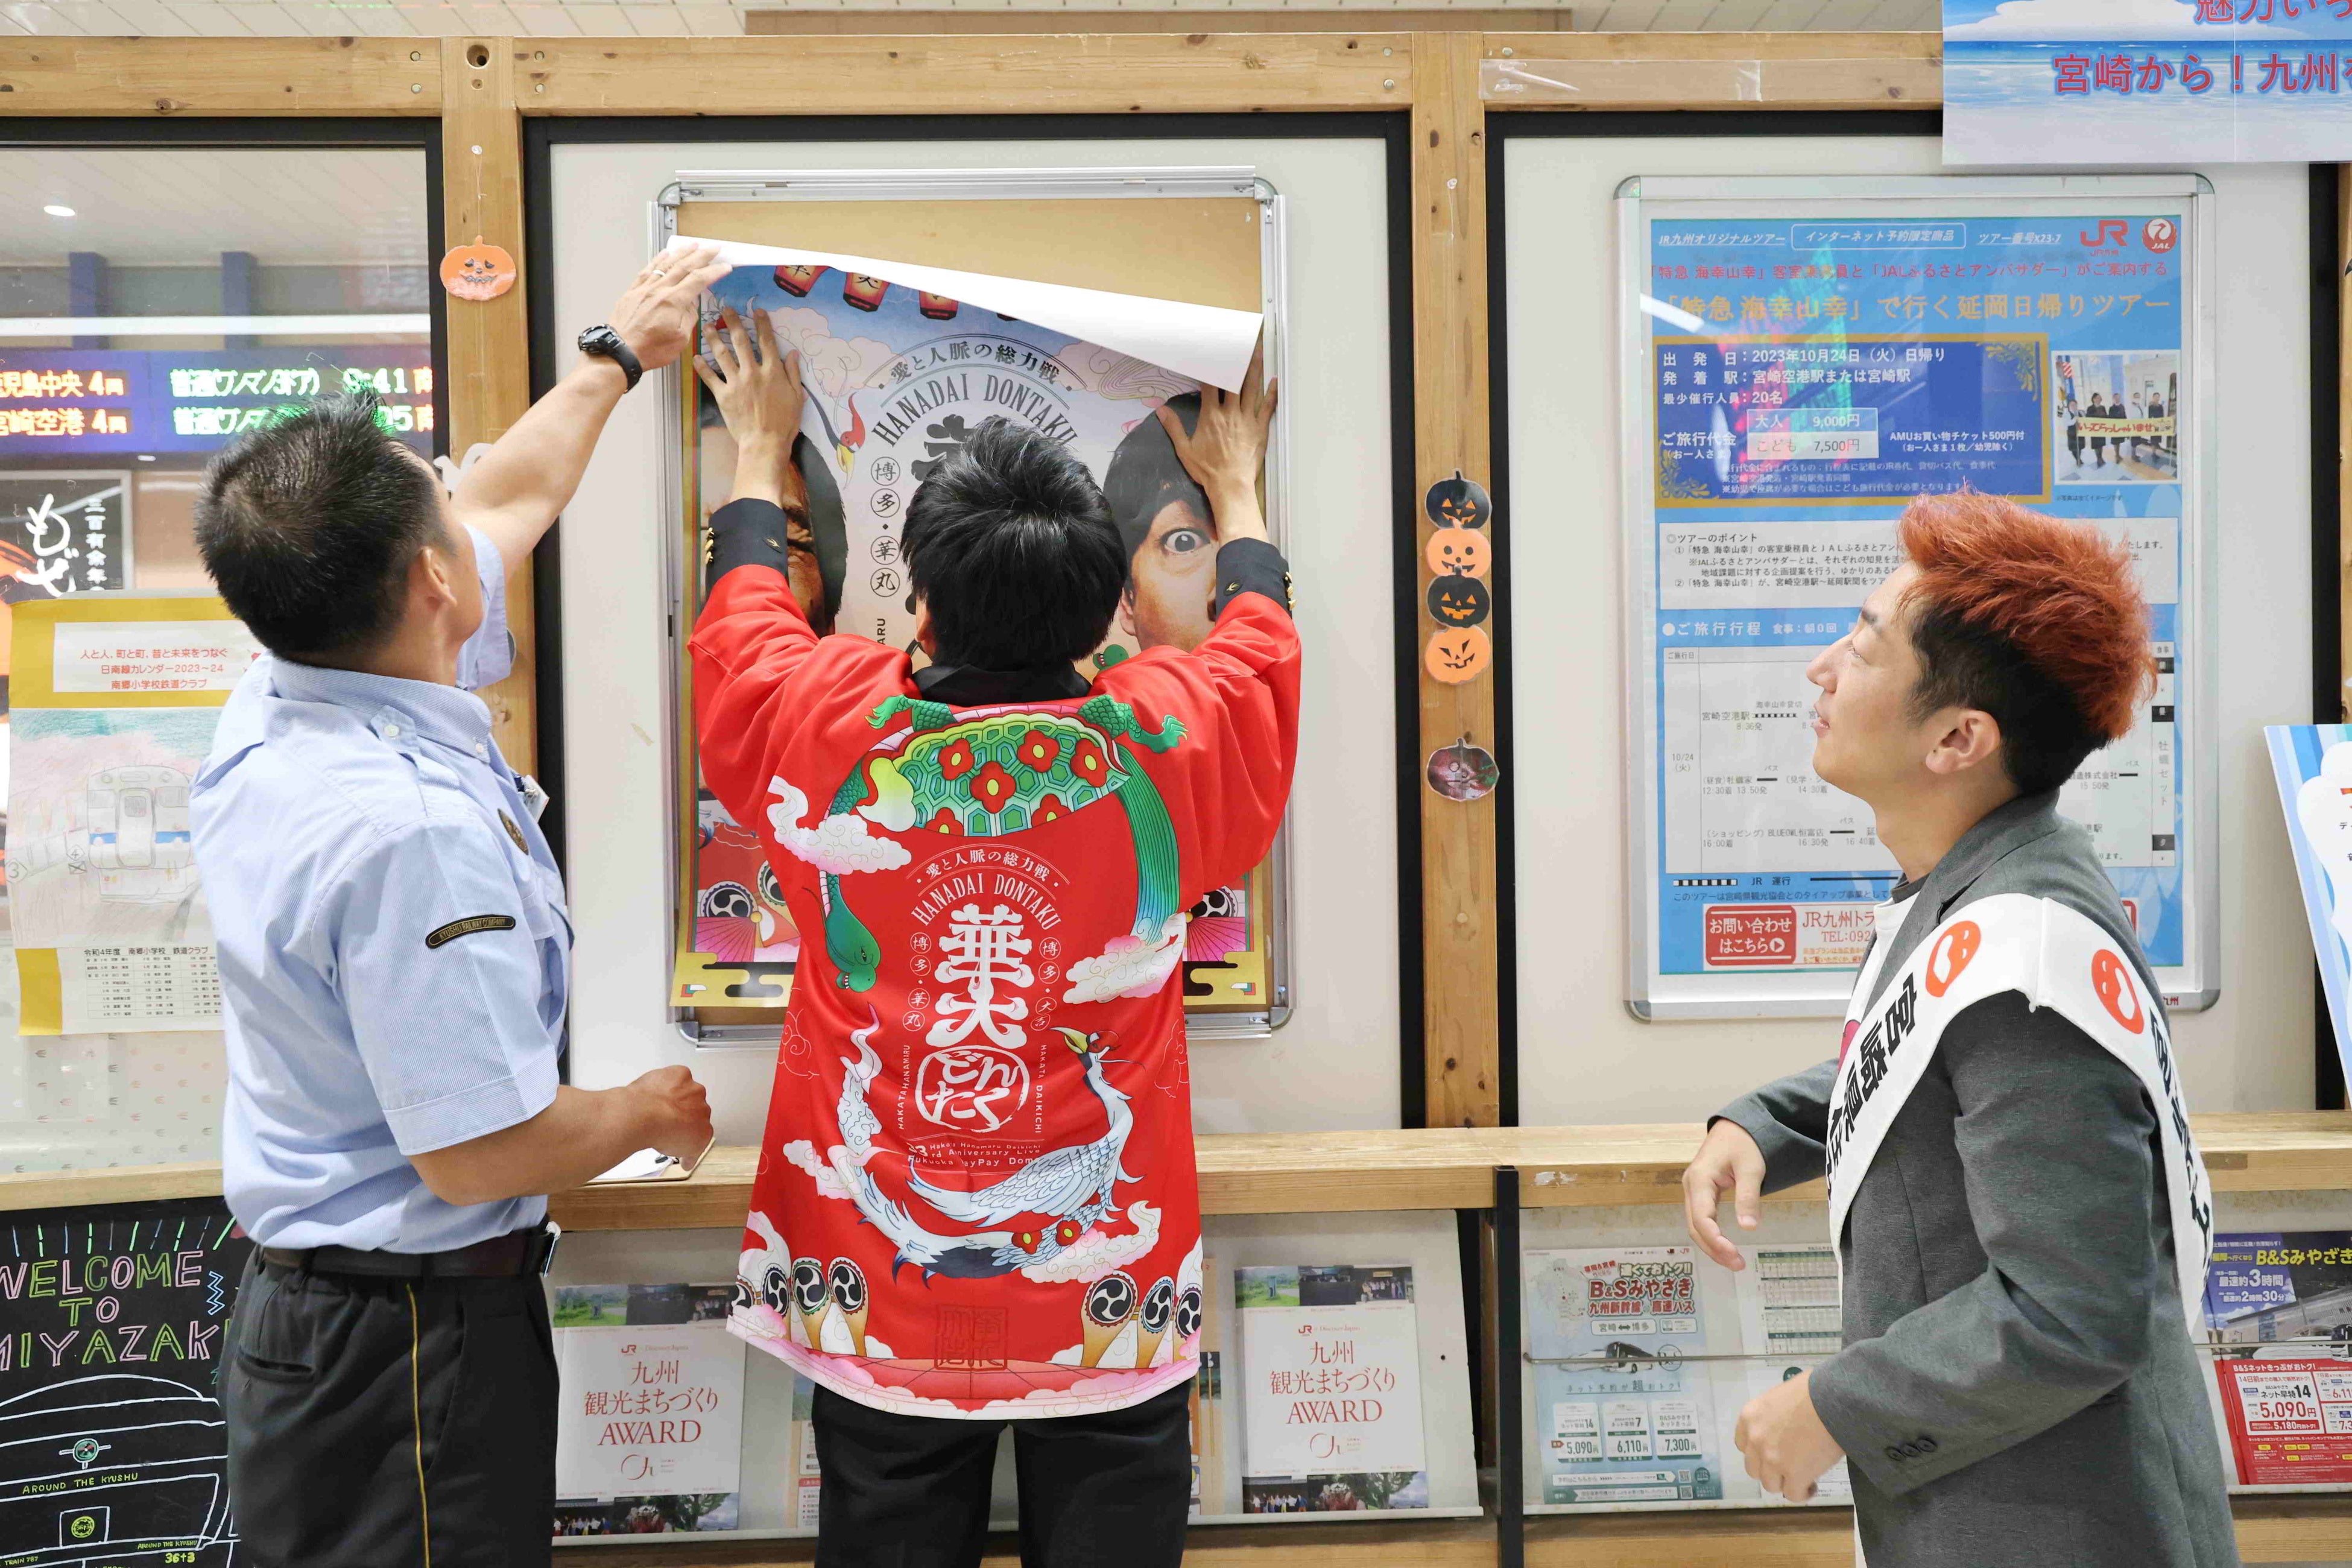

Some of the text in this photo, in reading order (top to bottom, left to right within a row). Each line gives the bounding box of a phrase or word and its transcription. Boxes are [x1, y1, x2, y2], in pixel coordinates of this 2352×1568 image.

[2053, 52, 2352, 93] 宮崎から！九州
[1659, 233, 1785, 245] JR九州オリジナルツアー
[1806, 229, 1954, 242] インターネット予約限定商品
[2081, 220, 2128, 247] JR
[890, 340, 1060, 385] 愛と人脈の総力戦
[0, 370, 84, 397] 児島中央
[871, 373, 970, 447] HANADAI
[1755, 414, 1784, 429] 大人
[1663, 431, 1736, 446] ご旅行代金
[1756, 439, 1859, 453] こども 7,500円
[925, 849, 1051, 880] 愛と人脈の総力戦
[910, 873, 1062, 931] HANADAI DONTAKU
[1709, 917, 1792, 935] お問い合わせ
[1720, 937, 1770, 953] はこちら
[1035, 1045, 1048, 1134] HAKATA DAIKICHI
[897, 1088, 908, 1130] HAKATA
[2256, 1247, 2352, 1266] B&Sみやざき
[1589, 1277, 1692, 1298] B&Sみやざき
[59, 1296, 119, 1327] TO
[1309, 1340, 1354, 1365] 九州
[630, 1360, 679, 1385] 九州
[1269, 1367, 1395, 1395] 観光まちづくり
[584, 1387, 718, 1416] 観光まちづくり
[1286, 1399, 1383, 1424] AWARD
[2260, 1401, 2316, 1418] 5,090円
[597, 1420, 701, 1446] AWARD
[22, 1472, 139, 1494] AROUND THE KYUSHU
[137, 1541, 162, 1550] AROUND
[165, 1552, 195, 1564] 36+3
[4, 1558, 25, 1566] TRAIN
